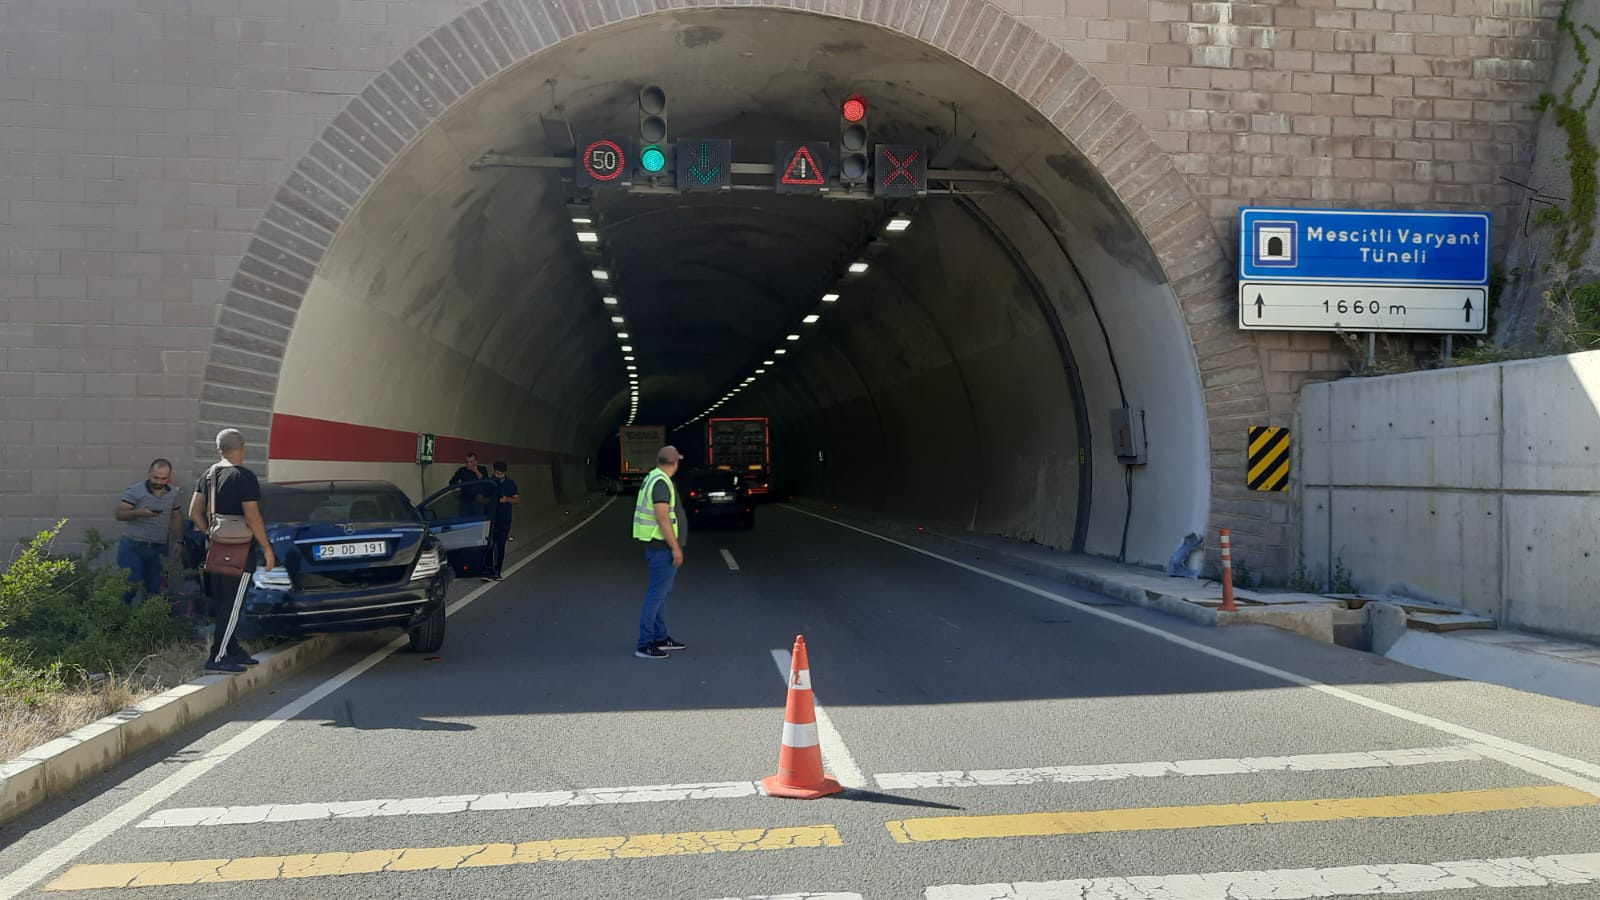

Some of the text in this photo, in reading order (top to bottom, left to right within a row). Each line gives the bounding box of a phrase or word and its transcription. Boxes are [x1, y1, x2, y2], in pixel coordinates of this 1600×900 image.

[592, 151, 616, 170] 50
[1307, 226, 1480, 249] Mescitli Varyant
[1359, 247, 1427, 264] Tüneli
[1322, 299, 1406, 315] 1660 m
[320, 546, 335, 556] 29
[364, 543, 383, 553] 191
